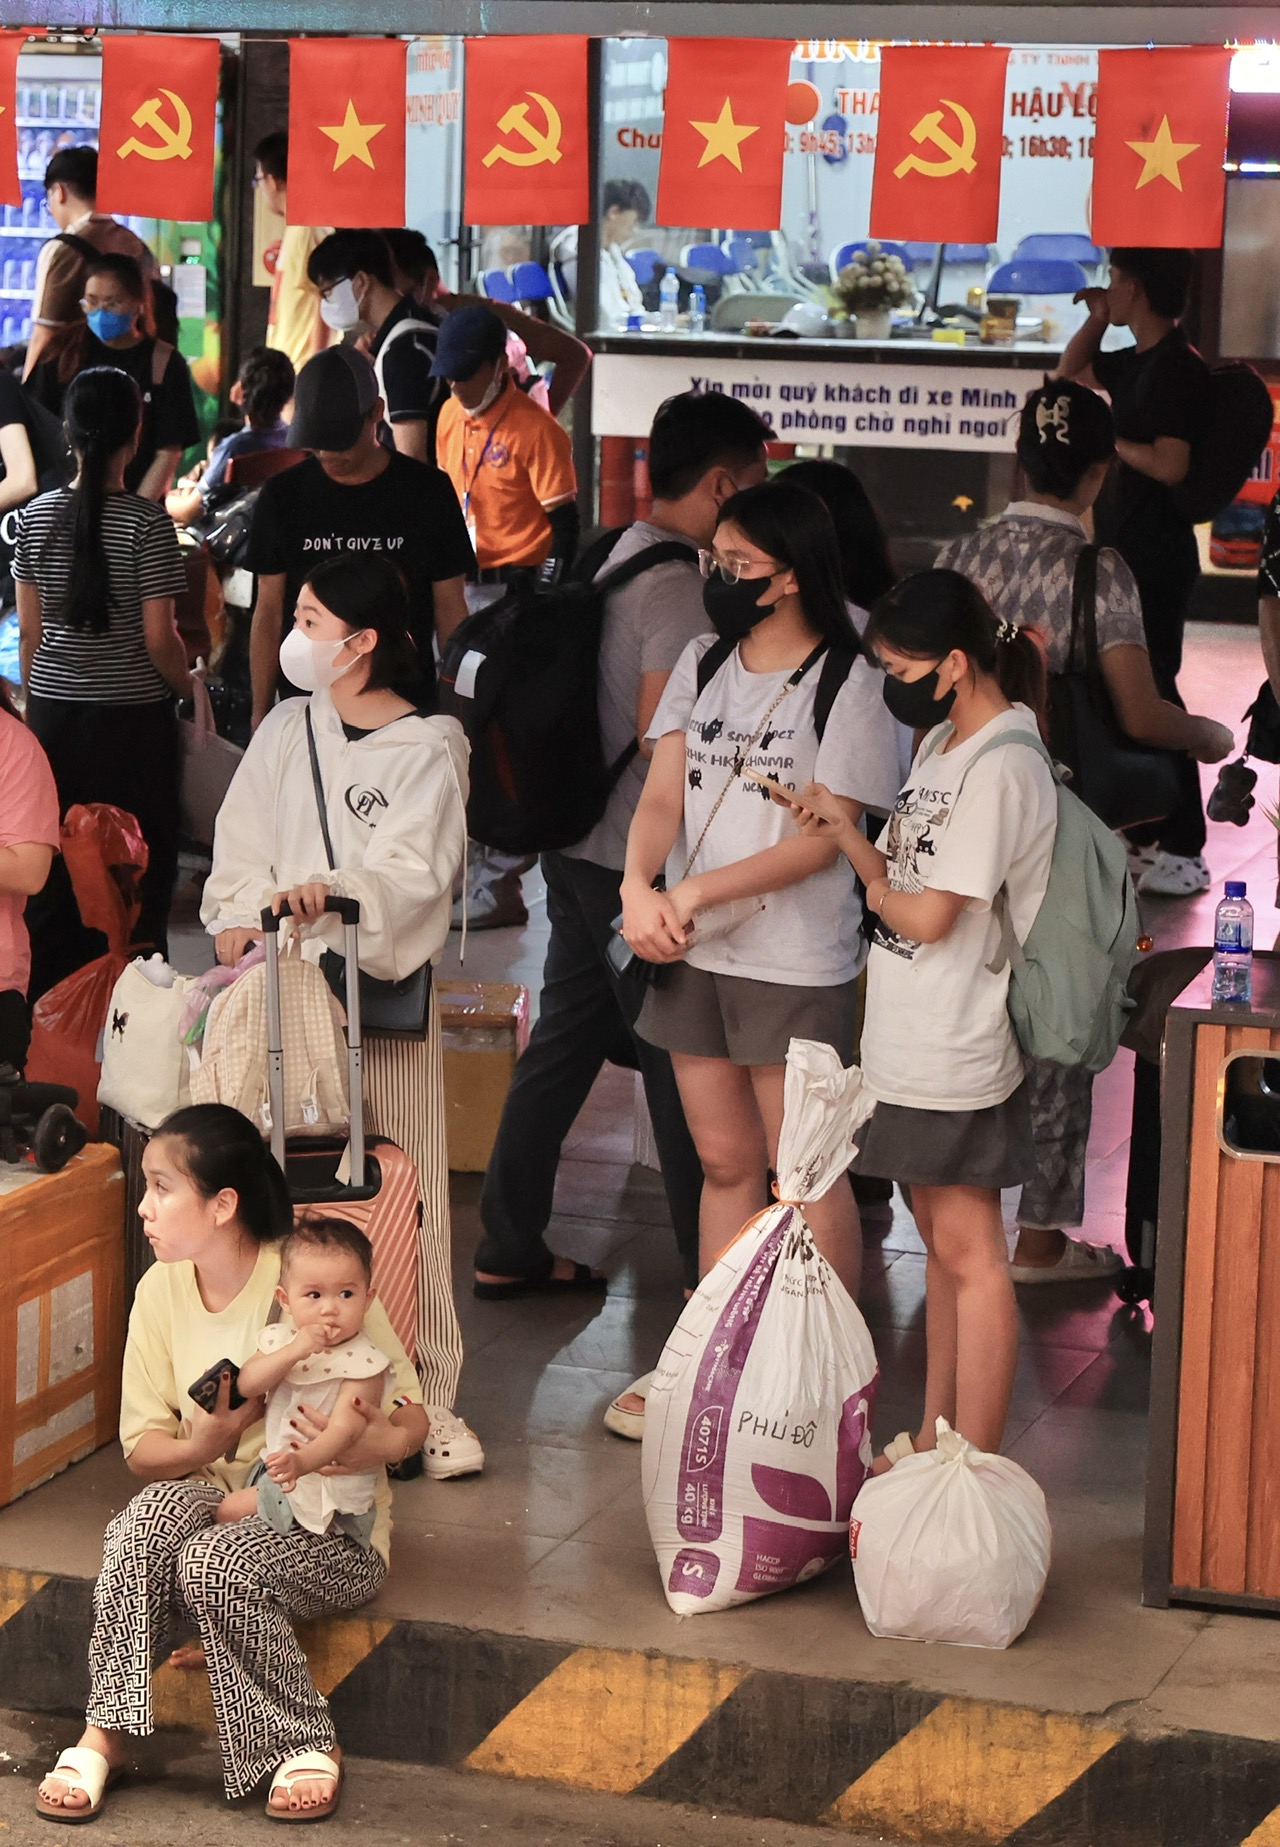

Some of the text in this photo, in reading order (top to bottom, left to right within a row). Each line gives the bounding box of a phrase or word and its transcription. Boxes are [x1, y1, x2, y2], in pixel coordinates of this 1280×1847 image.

[927, 390, 952, 406] xe
[962, 387, 1017, 409] Minh
[781, 409, 846, 434] phòng
[303, 533, 343, 551] DON'T
[387, 536, 404, 550] UP
[695, 1415, 712, 1465] 4071S
[791, 1420, 818, 1448] ĐÔ
[685, 1482, 696, 1502] 40
[682, 1561, 704, 1580] S
[755, 1563, 768, 1572] ISO
